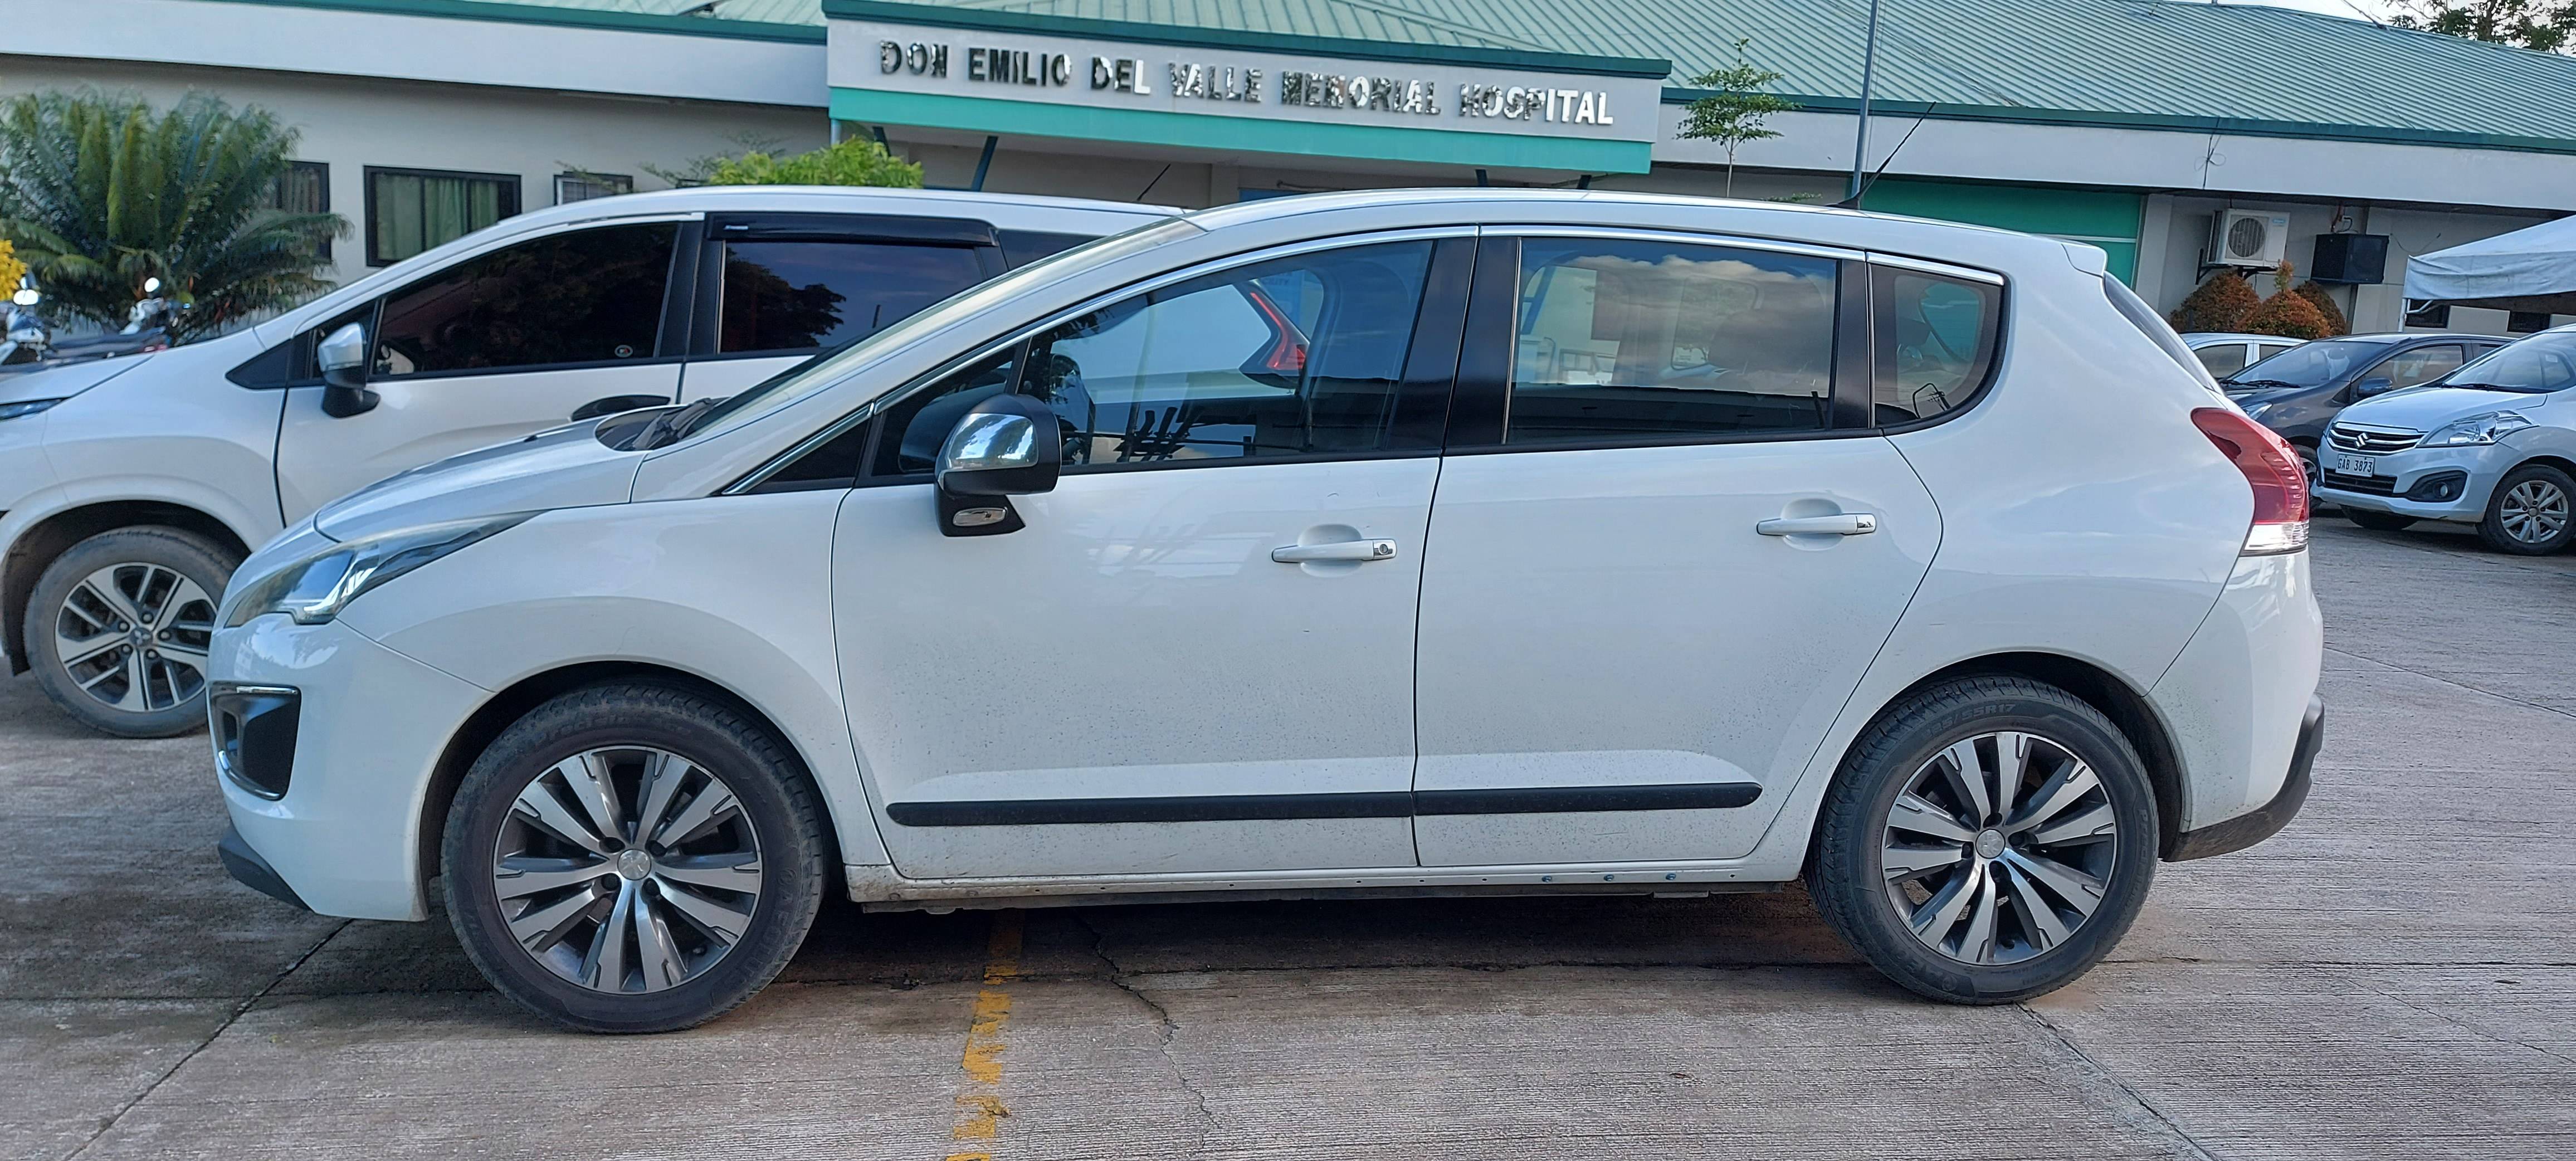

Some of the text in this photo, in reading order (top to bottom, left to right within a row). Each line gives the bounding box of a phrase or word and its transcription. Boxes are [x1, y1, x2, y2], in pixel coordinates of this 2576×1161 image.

[880, 40, 1613, 125] DON EMILIO DEL VALLE MEMORIAL HOSPITAL
[2337, 458, 2373, 473] GAB 3873
